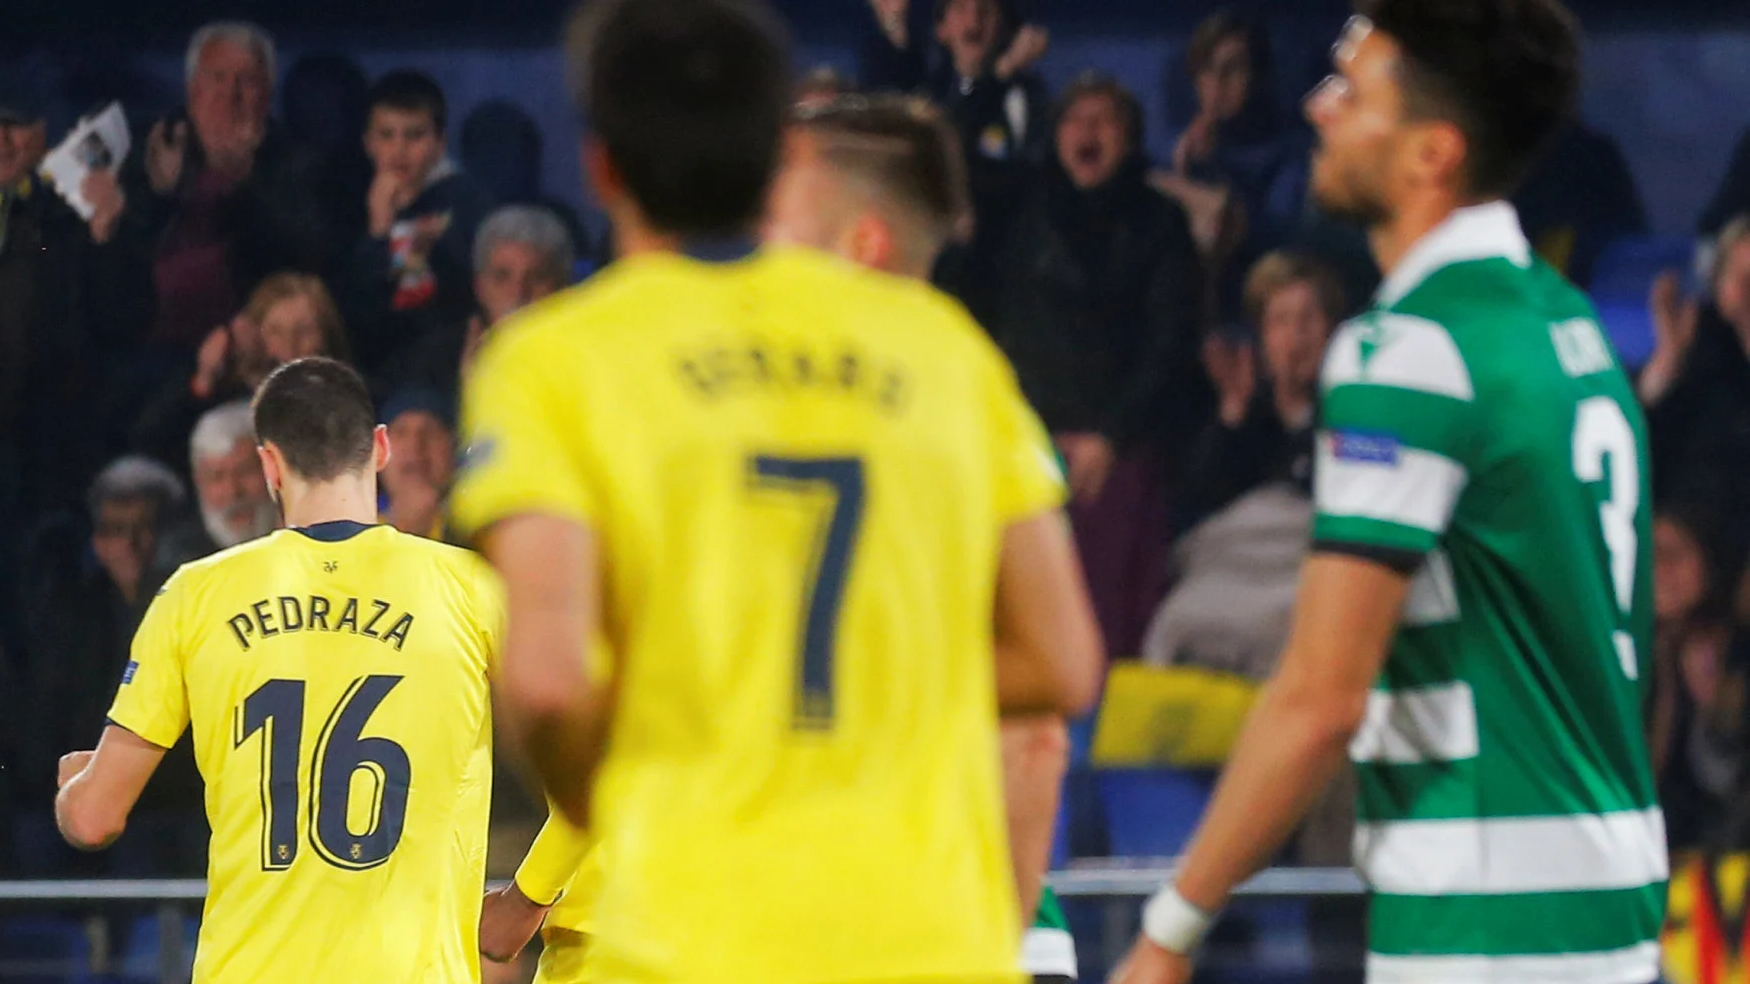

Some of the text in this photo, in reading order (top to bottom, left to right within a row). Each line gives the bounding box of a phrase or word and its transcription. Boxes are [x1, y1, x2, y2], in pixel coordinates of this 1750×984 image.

[227, 595, 415, 652] PEDRAZA
[747, 452, 868, 732] 7
[1571, 395, 1641, 681] 3
[234, 674, 411, 872] 16
